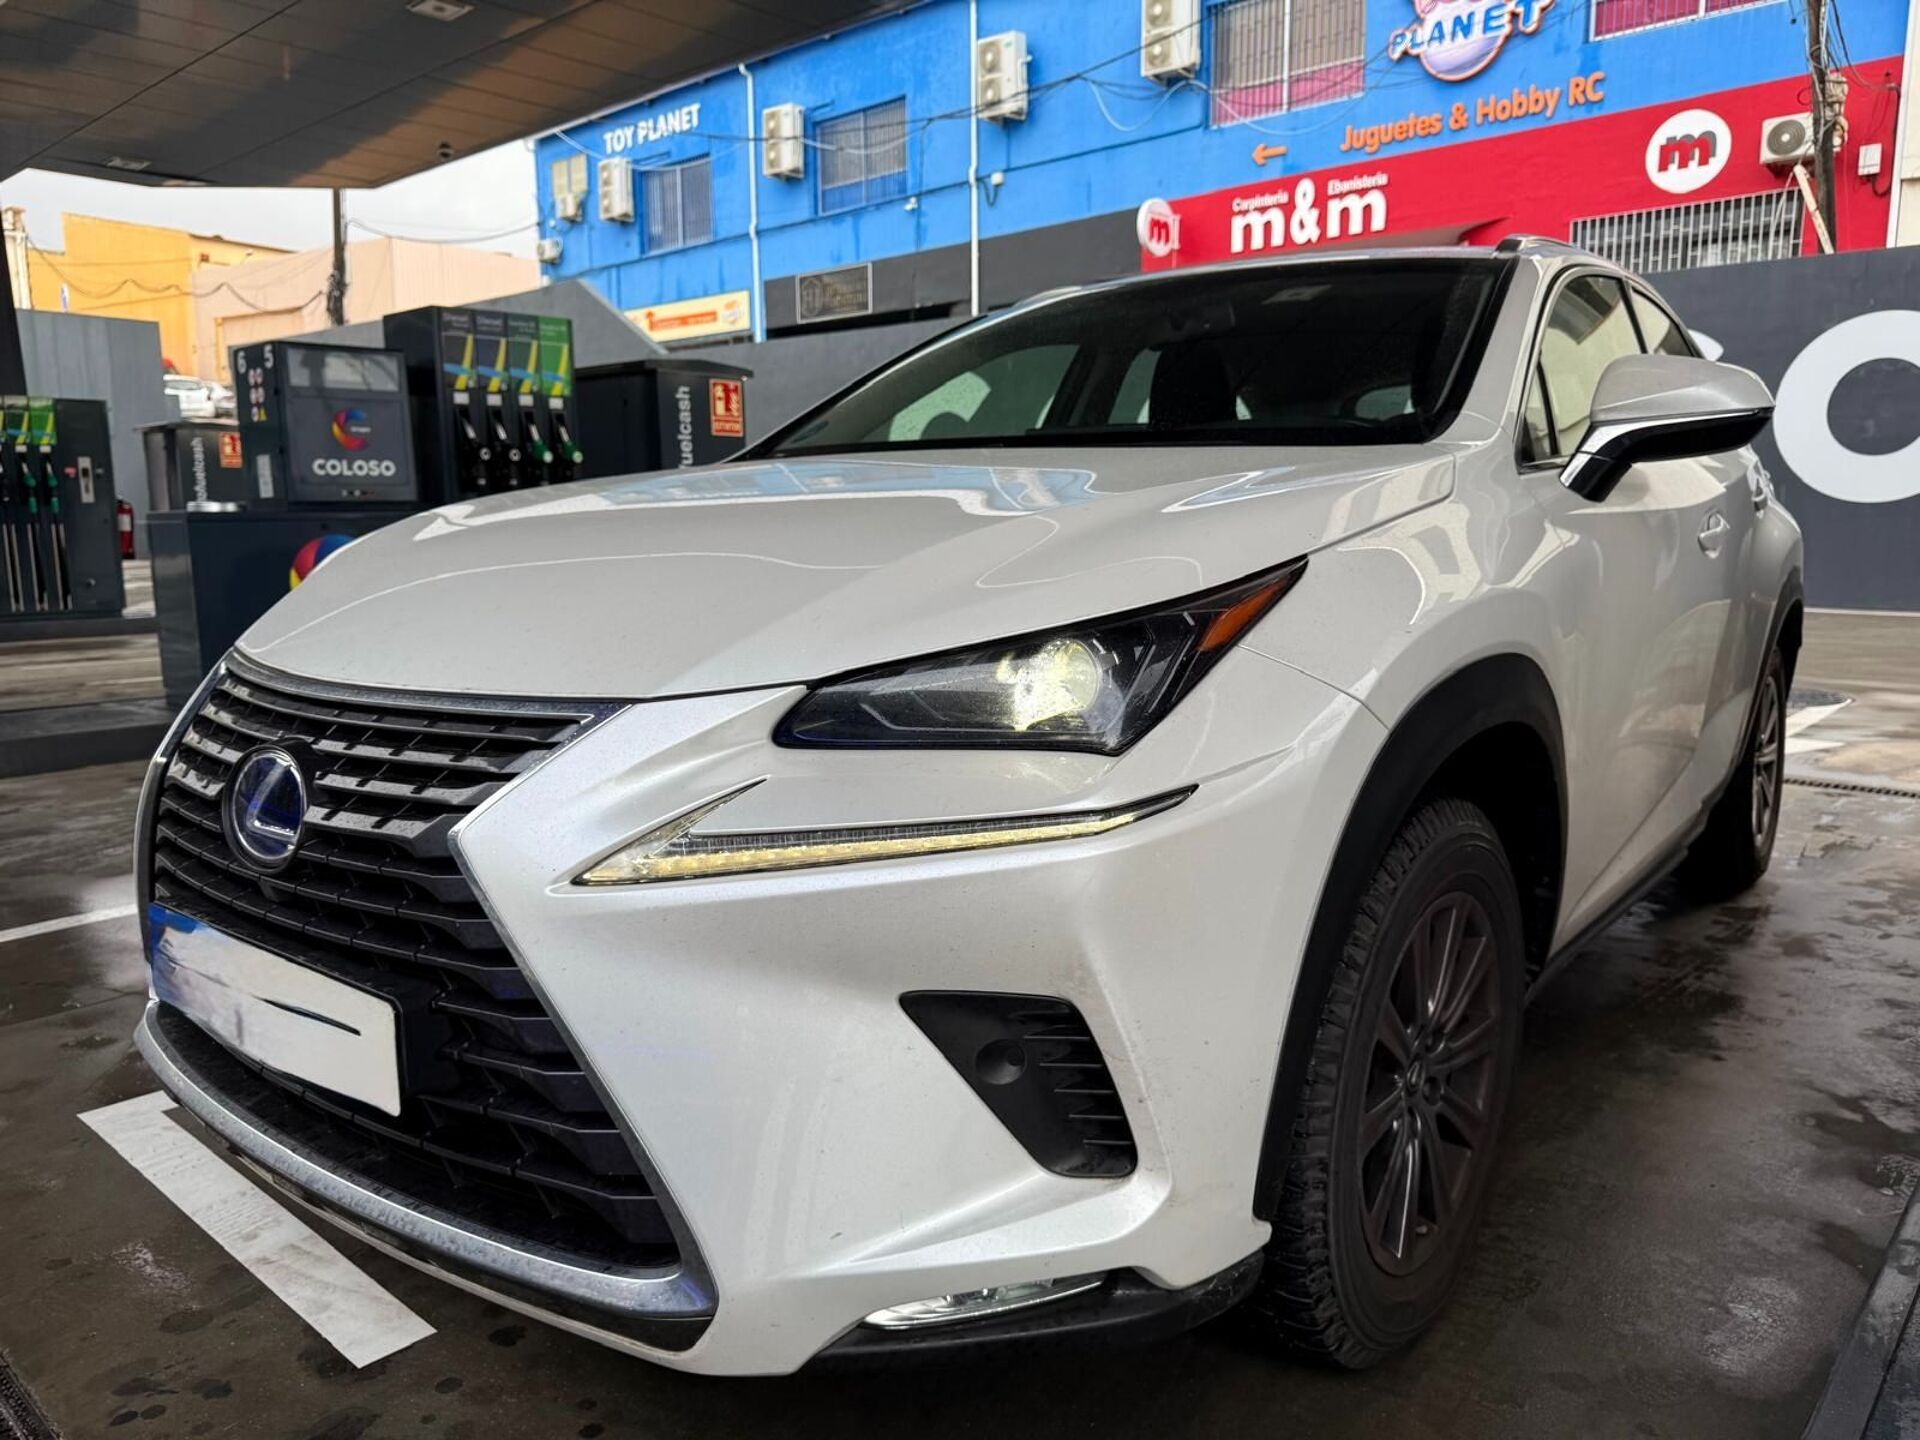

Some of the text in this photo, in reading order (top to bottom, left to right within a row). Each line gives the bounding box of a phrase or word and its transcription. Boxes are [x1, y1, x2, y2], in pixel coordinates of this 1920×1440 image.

[1391, 0, 1537, 50] PLANET
[603, 102, 701, 155] TOY PLANET
[1339, 71, 1606, 154] Juguetes & Hobby RC
[1230, 177, 1388, 254] m&m
[237, 350, 247, 375] 6
[264, 344, 274, 369] 5
[312, 458, 397, 477] COLOSO
